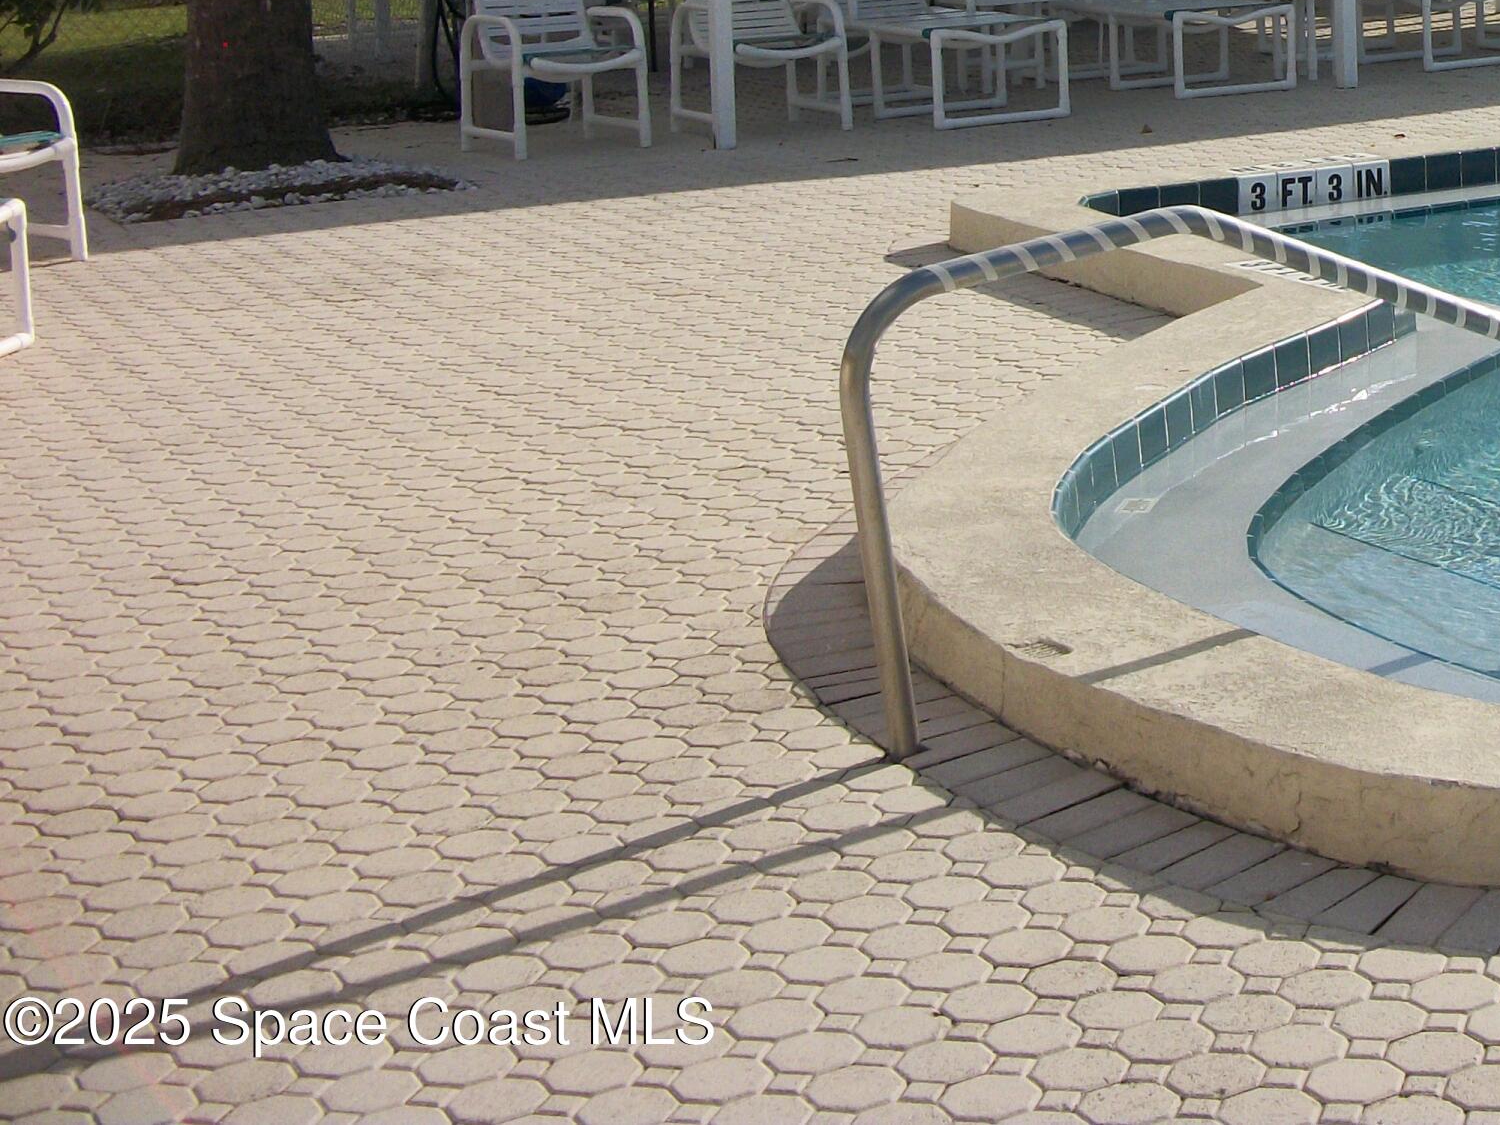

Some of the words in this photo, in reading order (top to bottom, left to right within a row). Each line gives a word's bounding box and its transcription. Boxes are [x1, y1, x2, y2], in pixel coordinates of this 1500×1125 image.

[1251, 182, 1266, 211] 3
[1281, 176, 1313, 207] FT.
[1328, 173, 1342, 202] 3
[1356, 167, 1388, 199] IN.
